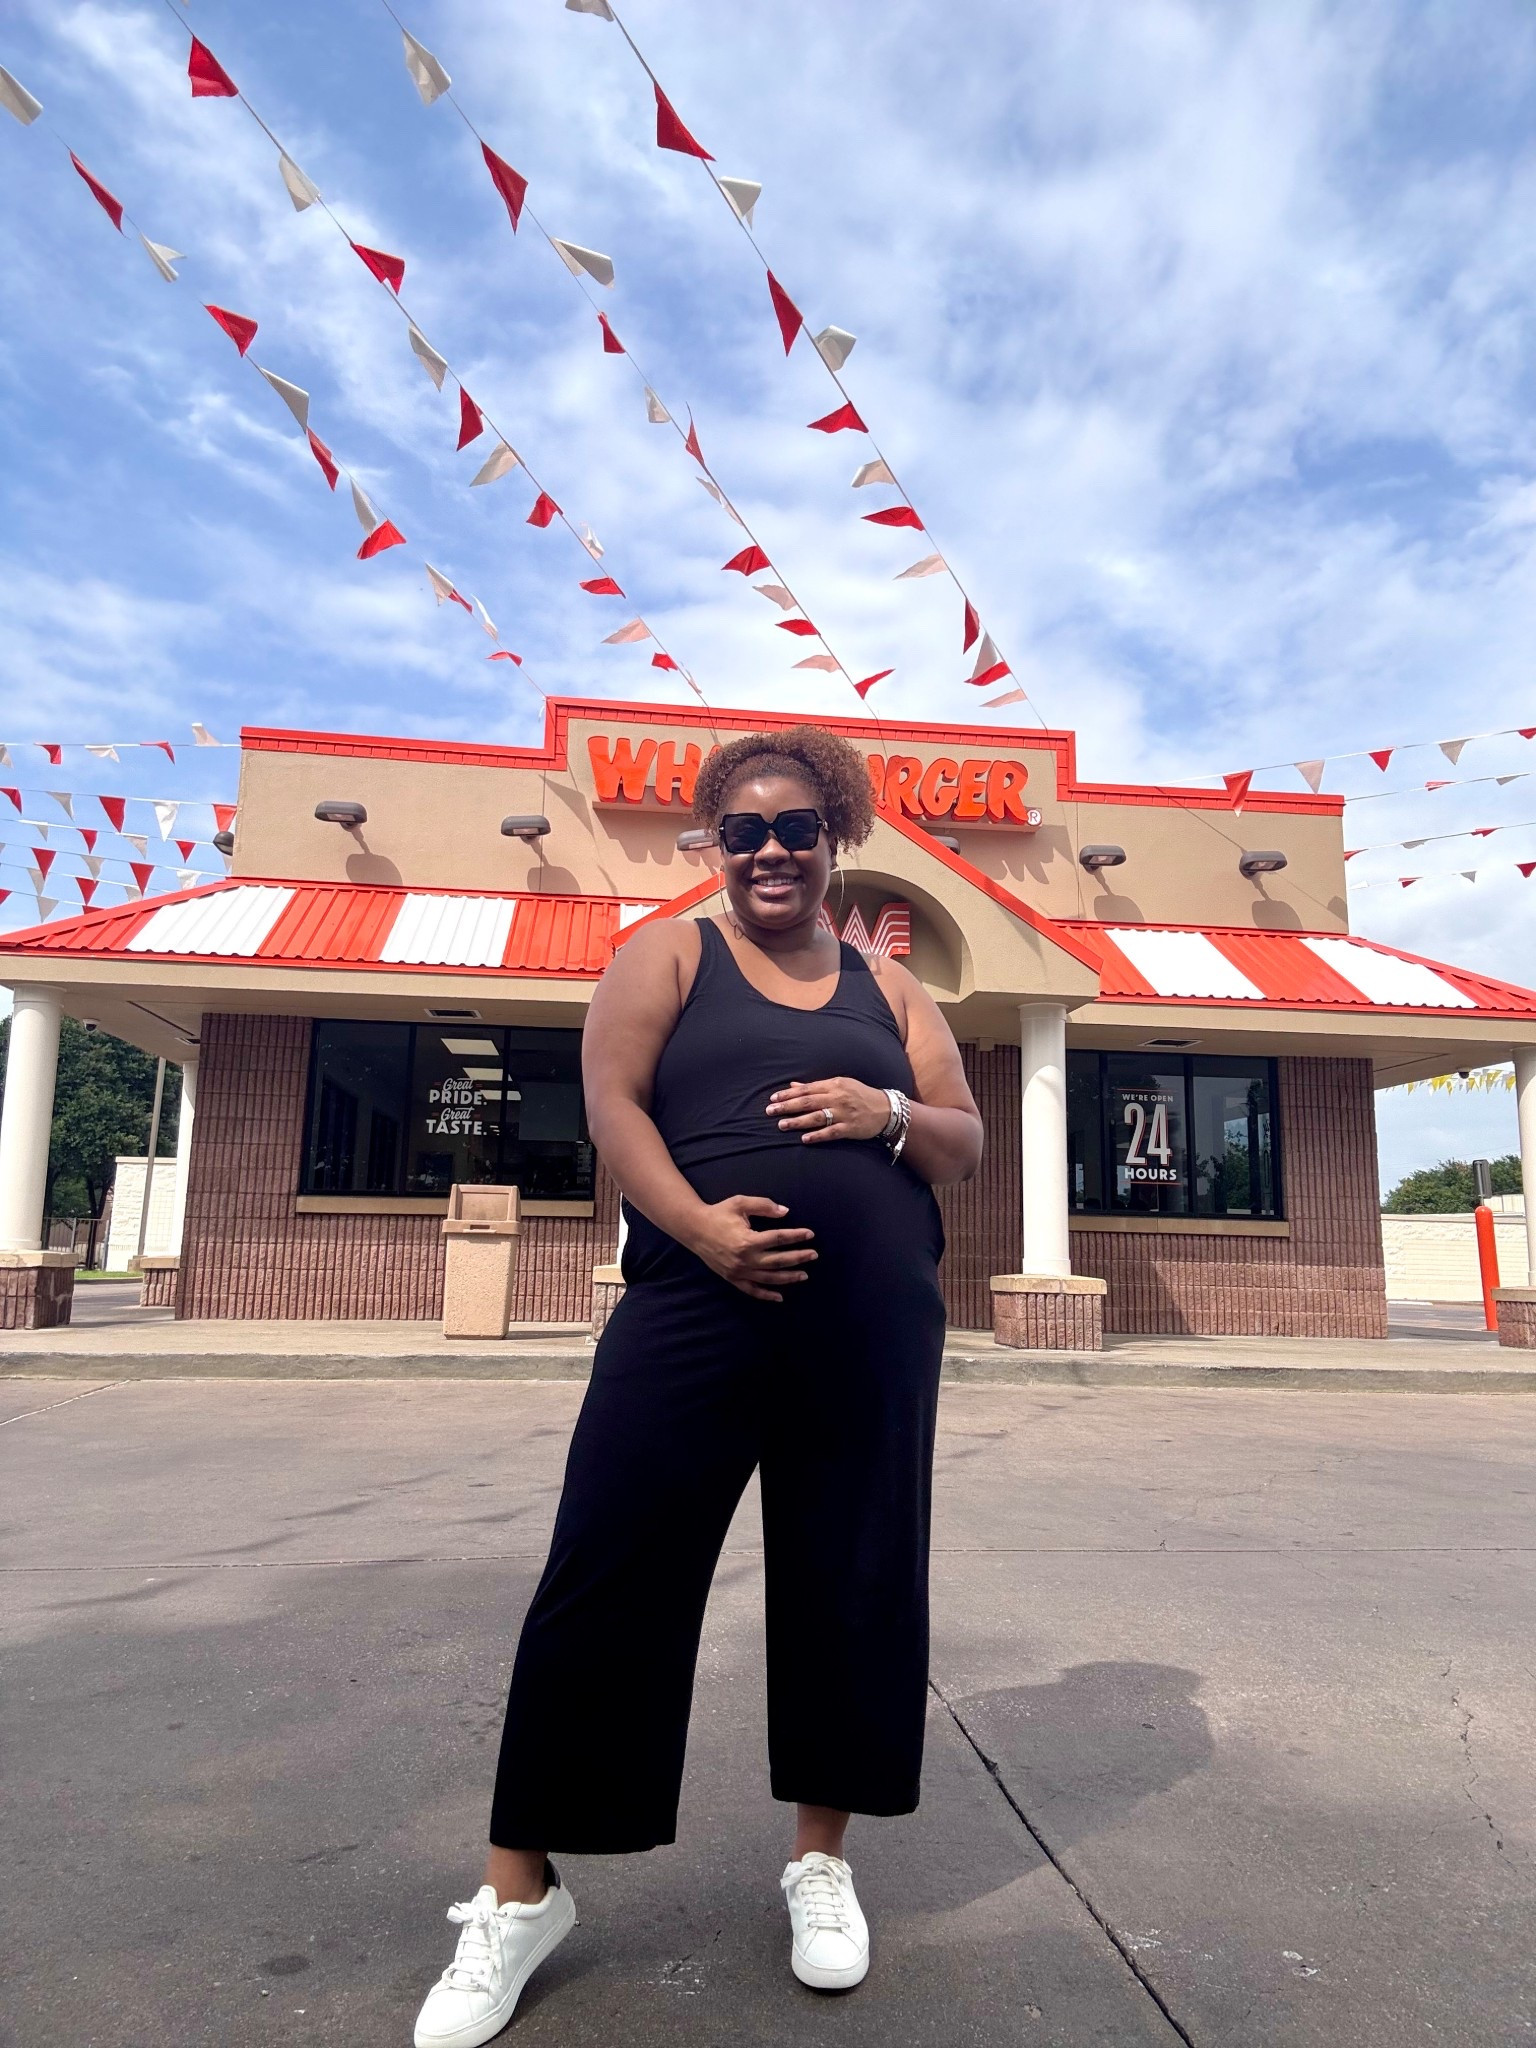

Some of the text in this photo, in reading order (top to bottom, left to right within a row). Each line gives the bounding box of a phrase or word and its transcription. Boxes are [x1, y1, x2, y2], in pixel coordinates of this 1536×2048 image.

[588, 736, 1028, 824] WHRGER
[443, 1077, 475, 1092] Great
[429, 1089, 487, 1106] PRIDE.
[1122, 1093, 1174, 1102] WE'RE OPEN
[440, 1106, 475, 1121] Great
[425, 1118, 487, 1136] TASTE.
[1124, 1103, 1173, 1166] 24
[1124, 1167, 1177, 1181] HOURS
